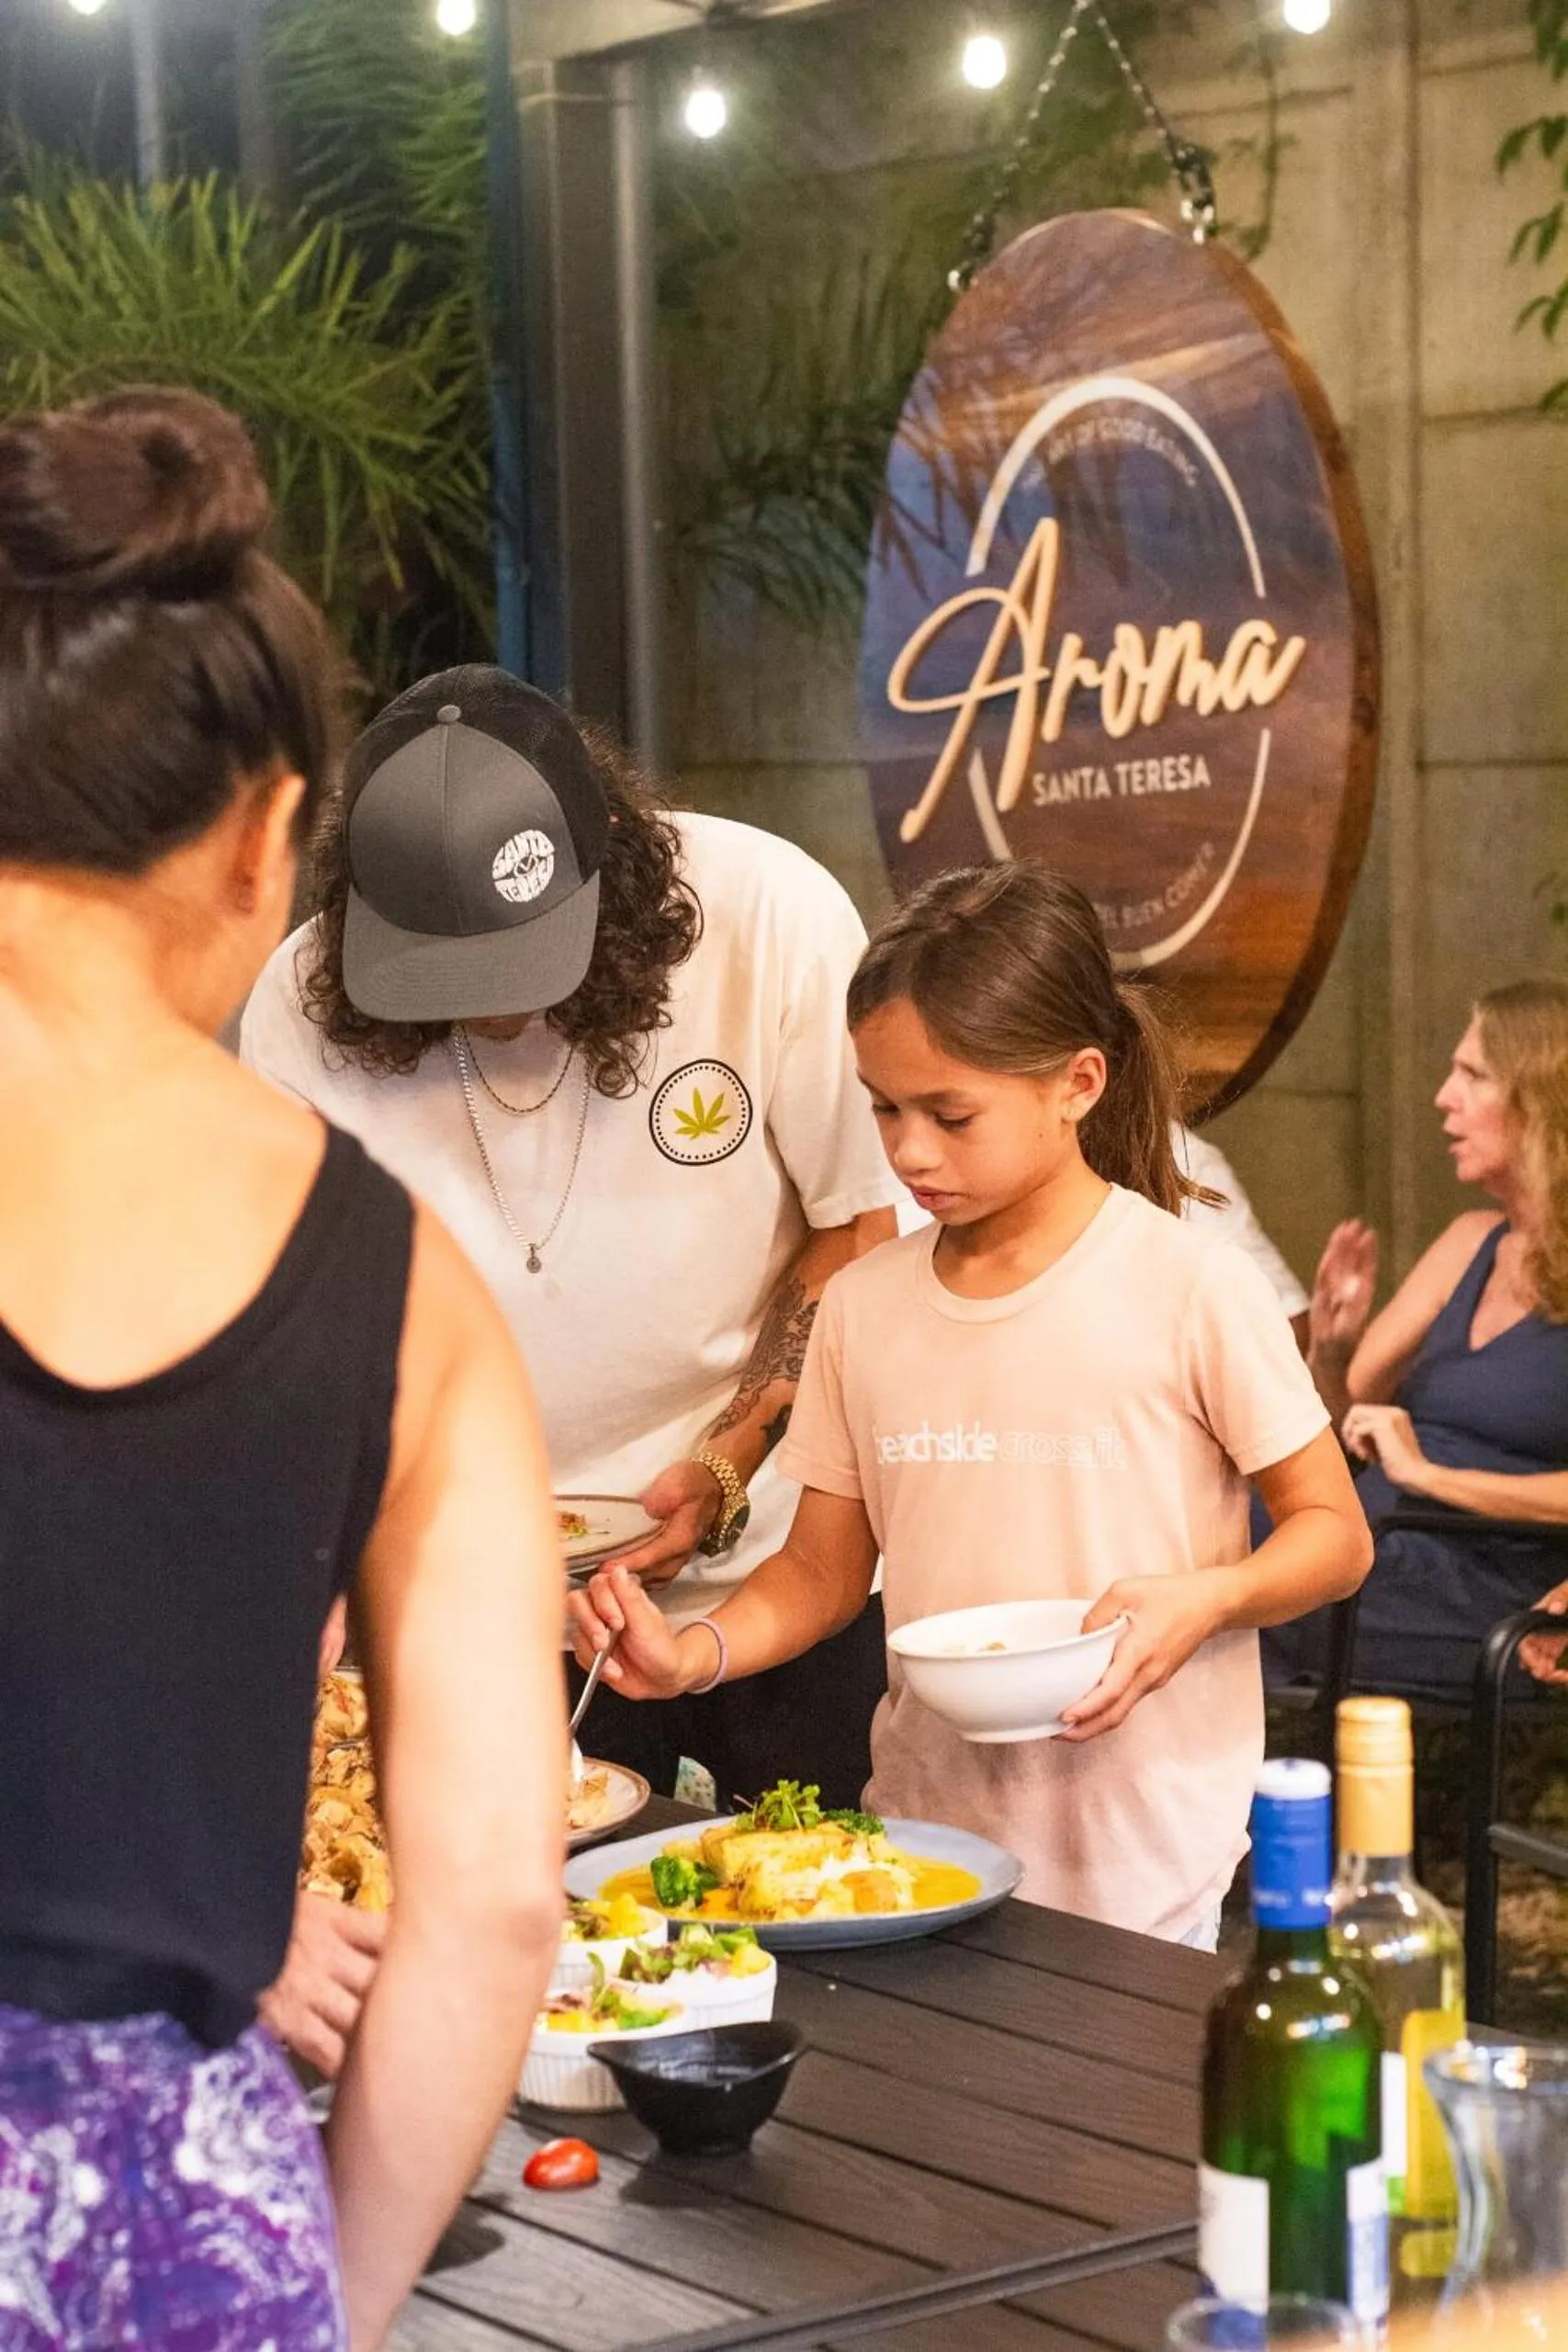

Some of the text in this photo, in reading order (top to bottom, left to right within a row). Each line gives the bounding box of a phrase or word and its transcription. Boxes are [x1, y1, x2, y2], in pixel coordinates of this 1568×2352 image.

[886, 516, 1307, 843] Aroma
[1032, 753, 1212, 807] SANTA TERESA
[877, 1419, 996, 1464] eachside
